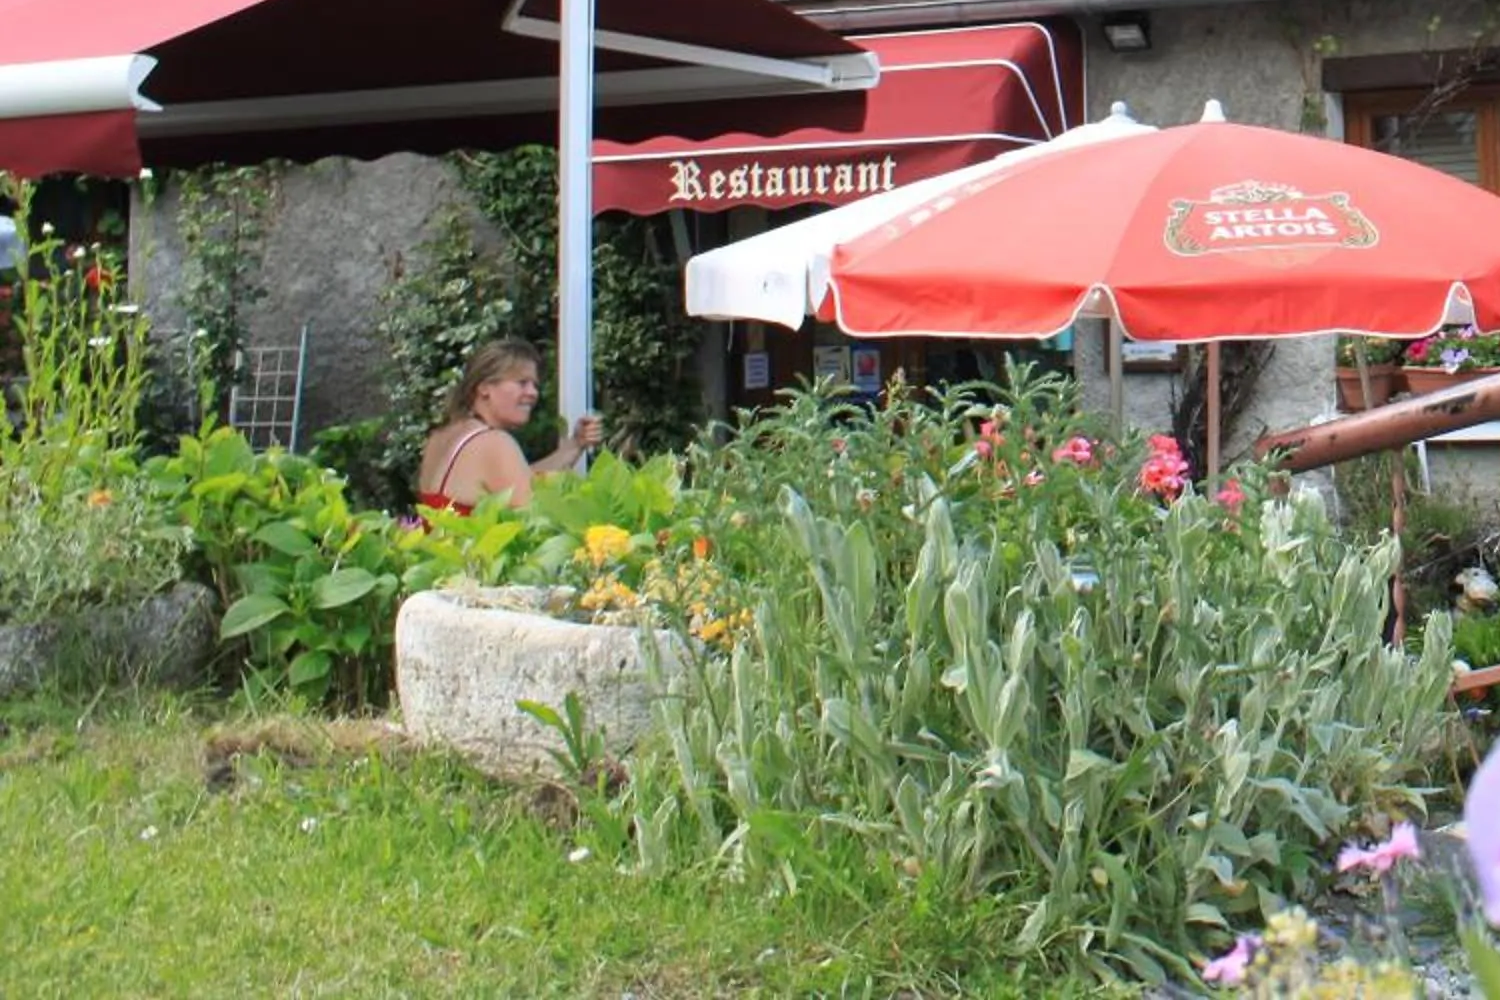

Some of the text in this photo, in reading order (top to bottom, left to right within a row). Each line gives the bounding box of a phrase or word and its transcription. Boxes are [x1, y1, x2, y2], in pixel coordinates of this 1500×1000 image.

[669, 154, 897, 202] Restaurant
[1204, 206, 1329, 225] STELLA
[1210, 221, 1339, 241] ARTOIS
